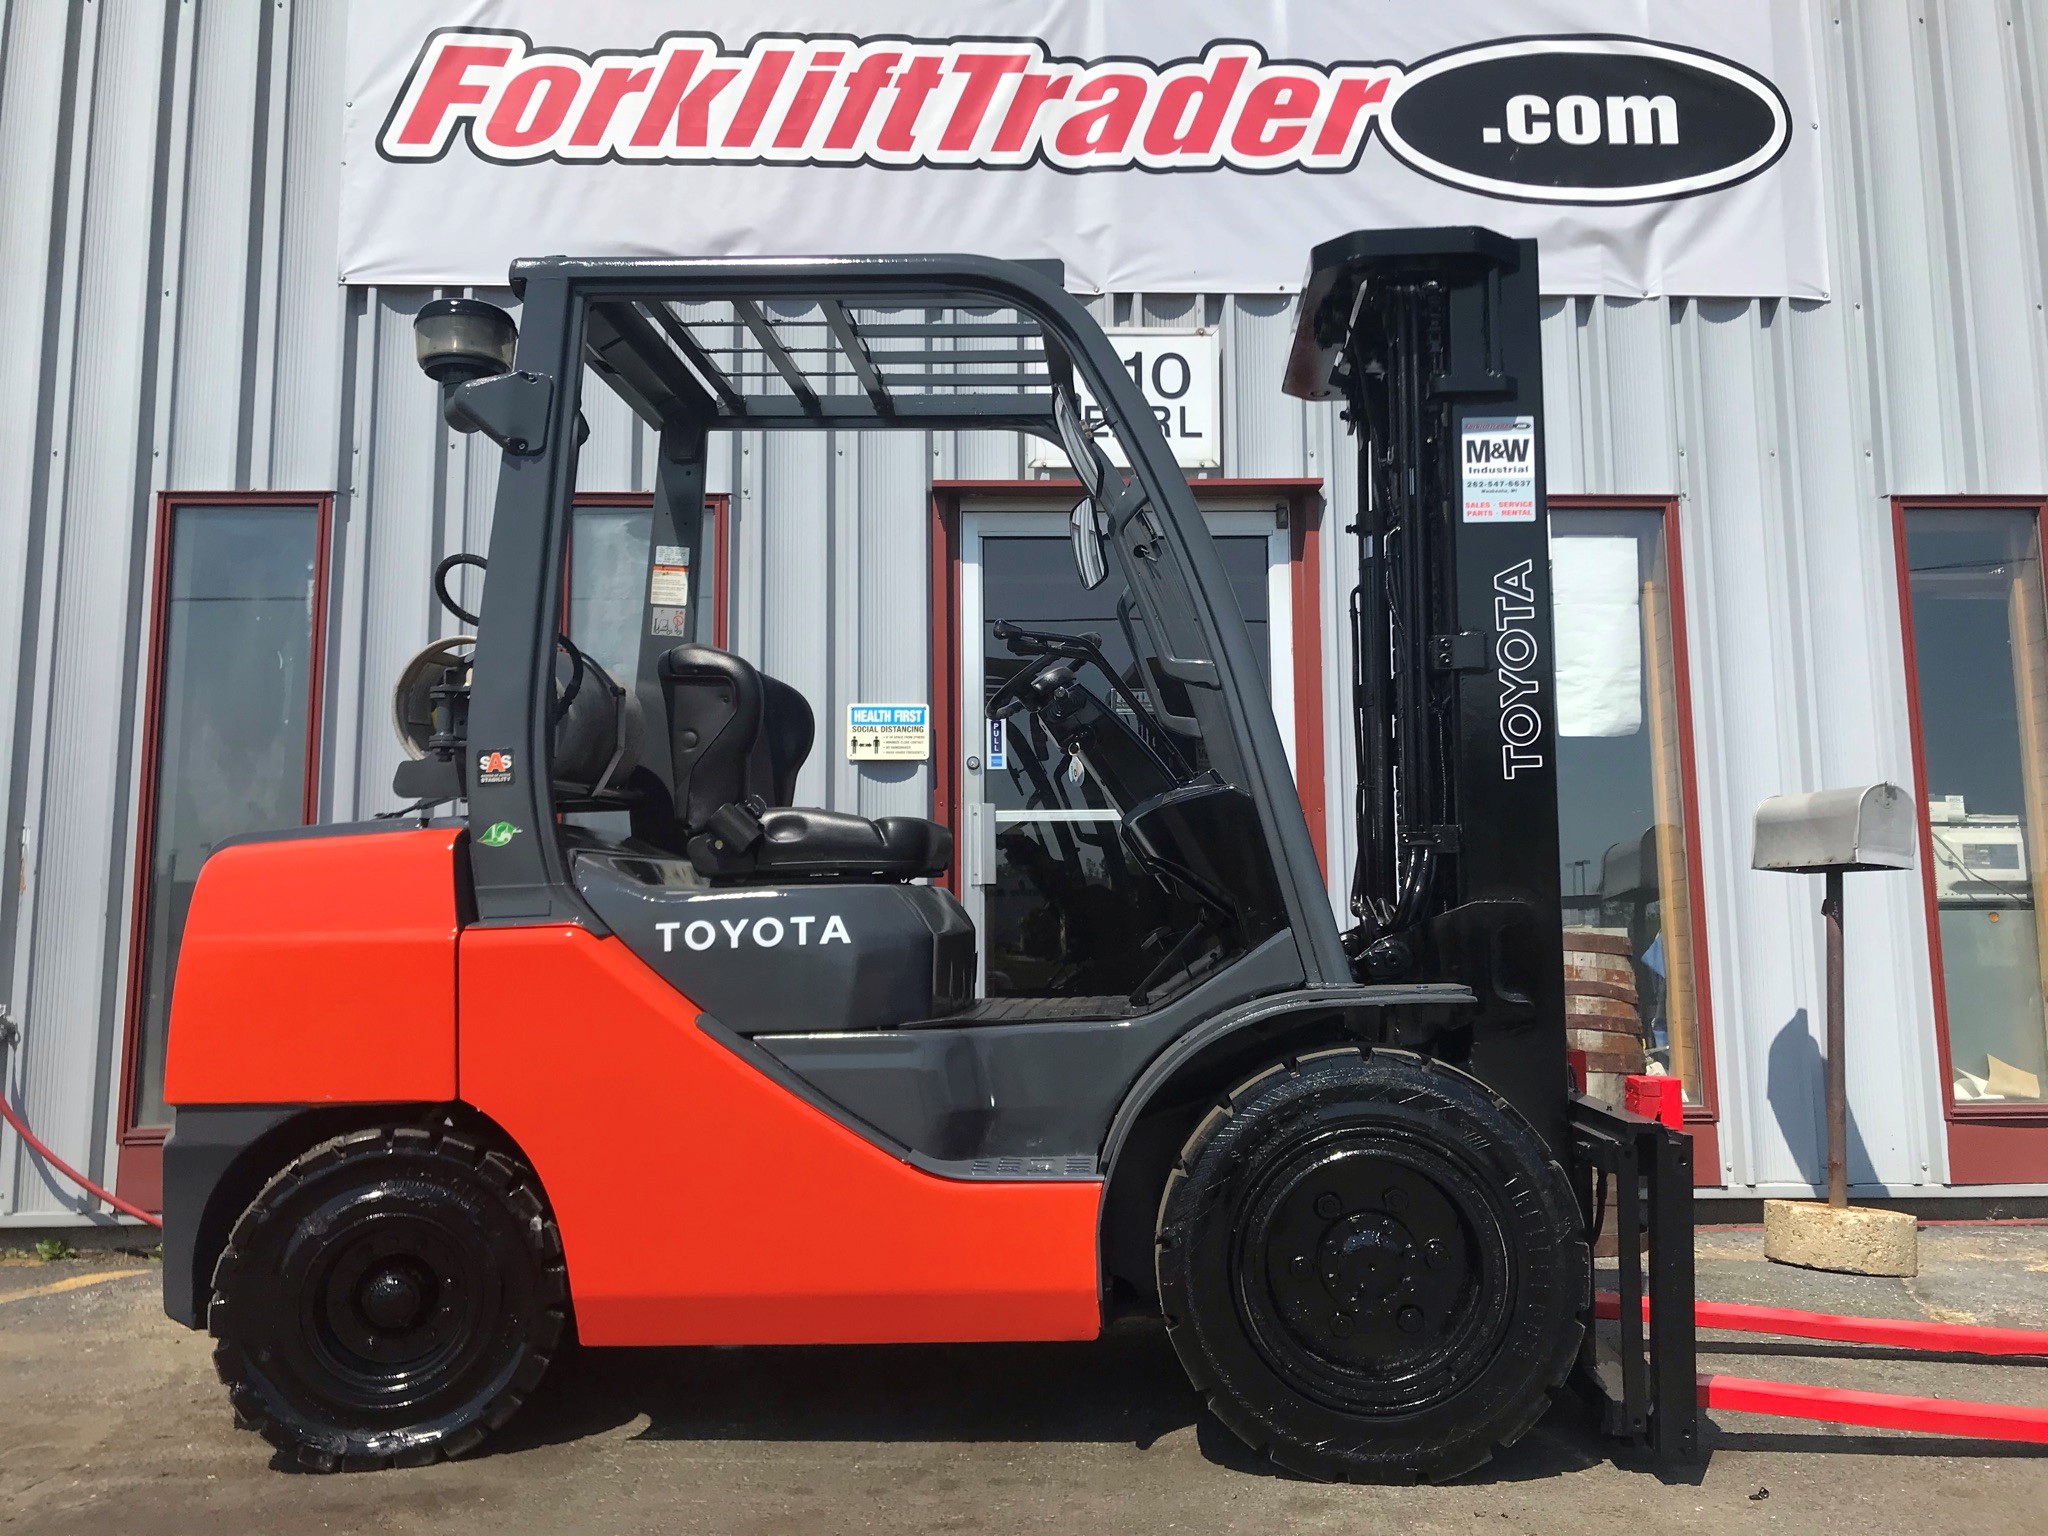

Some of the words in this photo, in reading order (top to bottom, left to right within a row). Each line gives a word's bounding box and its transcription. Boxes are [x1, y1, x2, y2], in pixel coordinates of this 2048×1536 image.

[397, 45, 1390, 157] ForkliftTrader
[1482, 94, 1680, 151] .com
[1466, 438, 1530, 463] M&W
[1468, 466, 1529, 474] Industrial
[1494, 558, 1543, 780] TOYOTA
[853, 710, 891, 723] HEALTH
[894, 709, 922, 723] FIRST
[479, 752, 512, 773] SAS
[655, 915, 852, 952] TOYOTA
